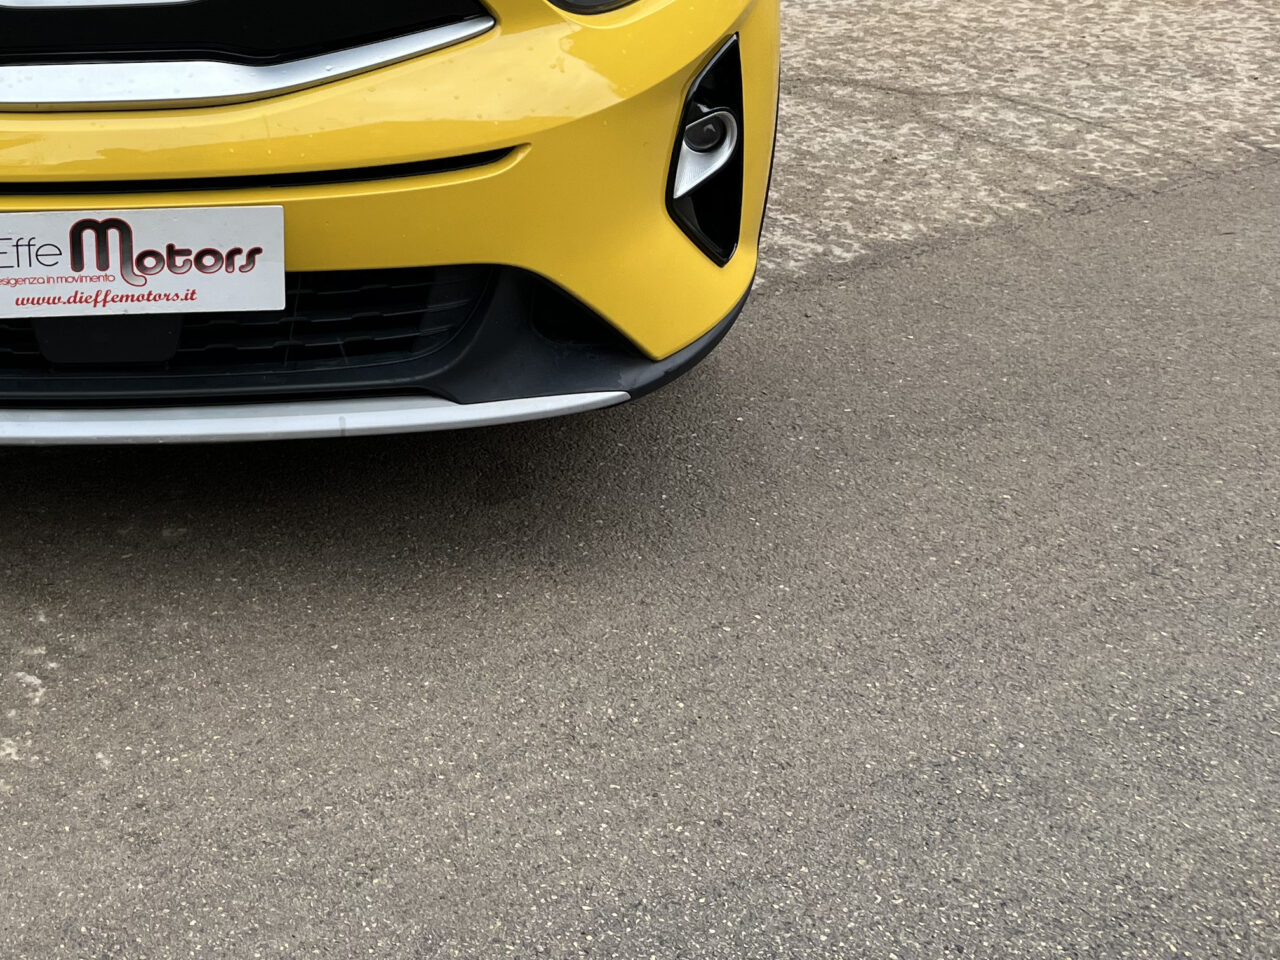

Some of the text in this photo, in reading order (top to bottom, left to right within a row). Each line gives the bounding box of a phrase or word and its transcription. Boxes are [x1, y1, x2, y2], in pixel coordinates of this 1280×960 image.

[69, 217, 264, 287] Motors
[46, 275, 56, 285] in
[56, 273, 117, 285] movimento
[14, 288, 198, 308] www.dieffemotors.it
